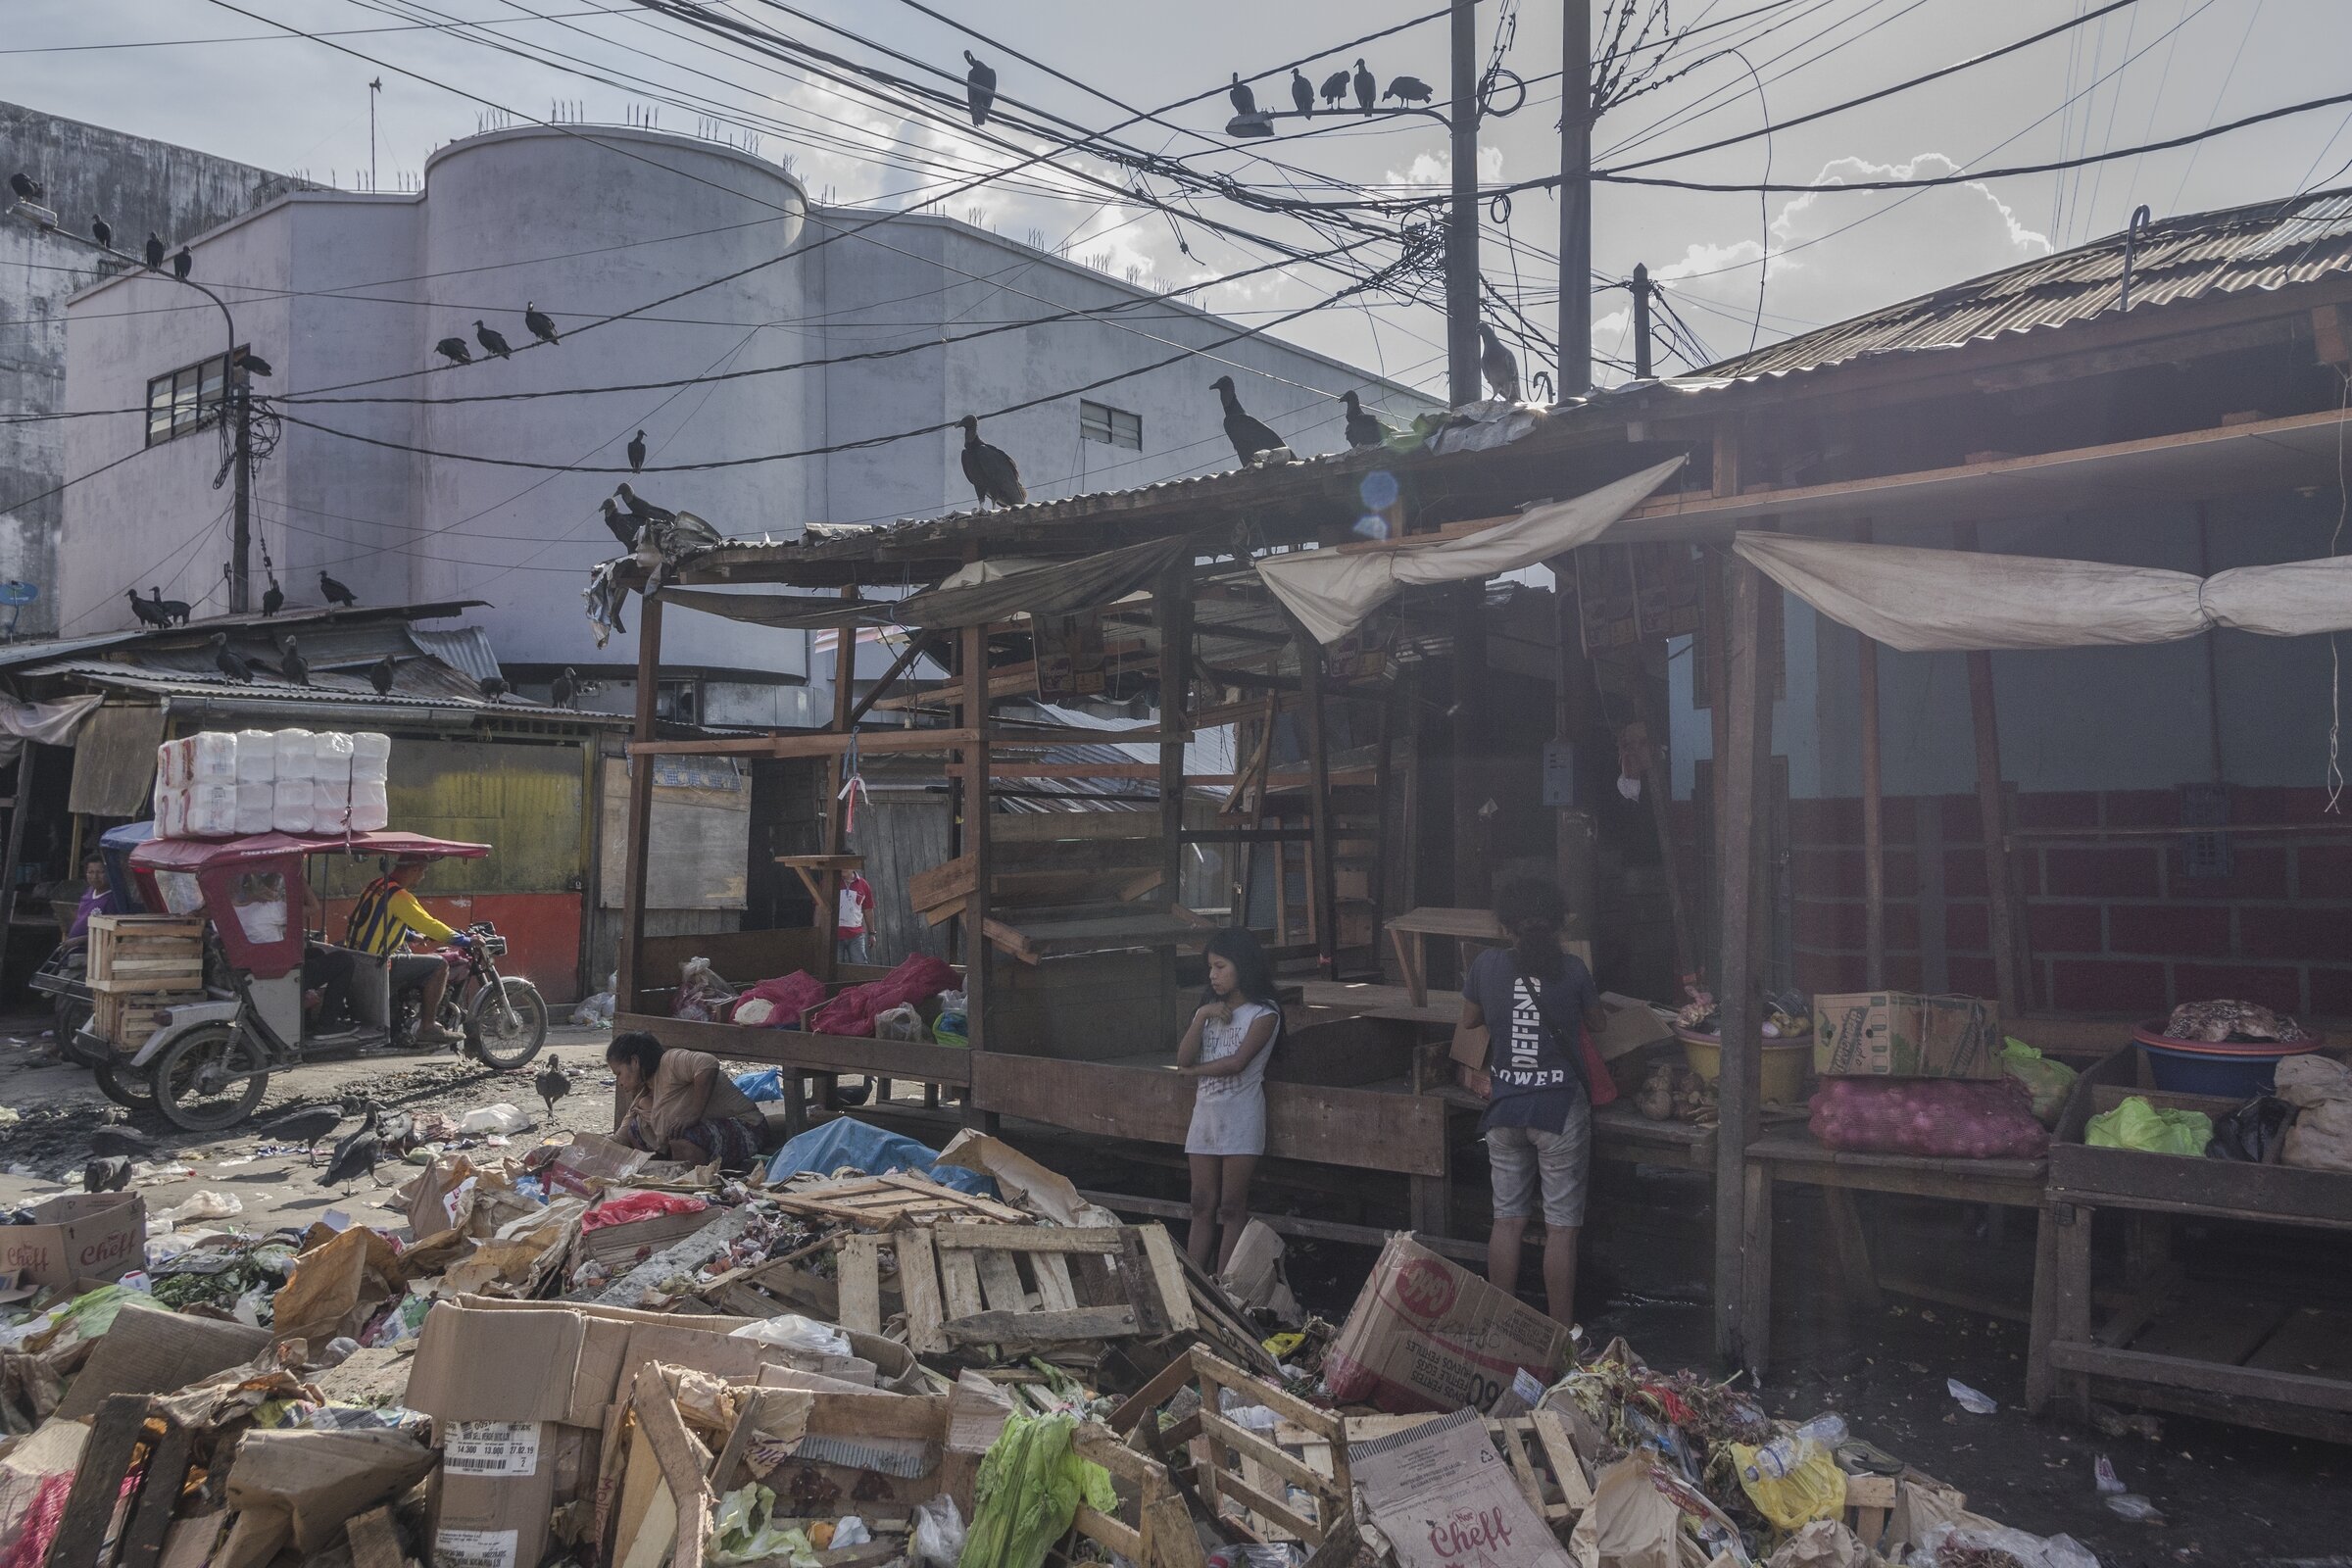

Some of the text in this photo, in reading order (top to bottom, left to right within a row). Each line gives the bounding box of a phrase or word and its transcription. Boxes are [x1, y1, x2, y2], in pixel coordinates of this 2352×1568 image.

[1511, 976, 1542, 1069] DEFEND
[8, 1247, 49, 1272] Cheff
[80, 1229, 136, 1266] Cheff
[1405, 1339, 1471, 1378] HUEVOS FERTILES
[1416, 1358, 1470, 1392] FERTILE EGGS
[1444, 1386, 1466, 1403] OVOS
[1430, 1505, 1512, 1558] Cheff
